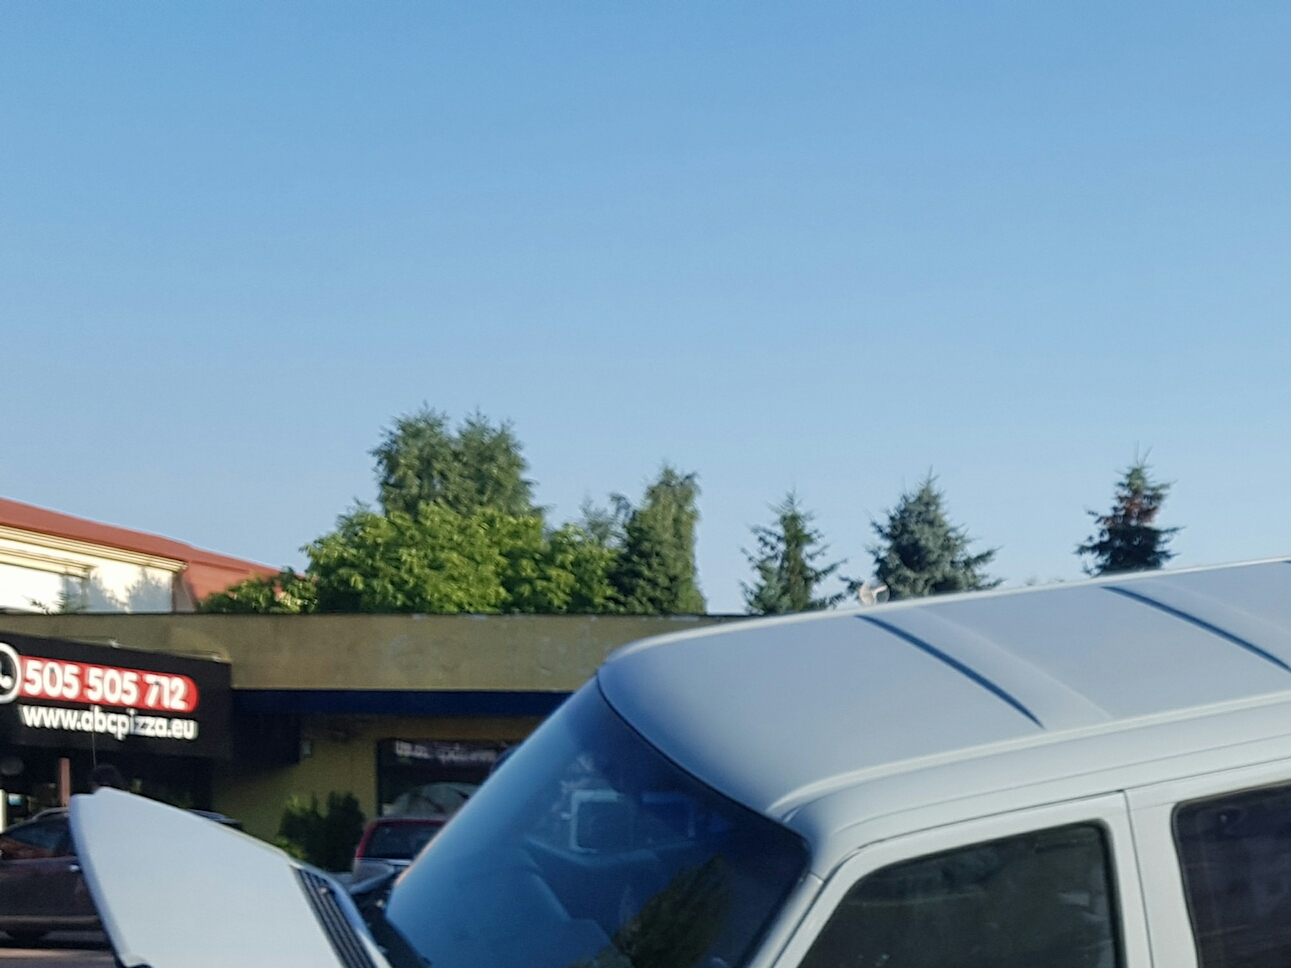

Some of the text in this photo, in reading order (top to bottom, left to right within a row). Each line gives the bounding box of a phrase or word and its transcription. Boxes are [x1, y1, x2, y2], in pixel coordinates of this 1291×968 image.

[24, 660, 188, 709] 505 505 712
[20, 704, 197, 740] www.abcpizza.eu
